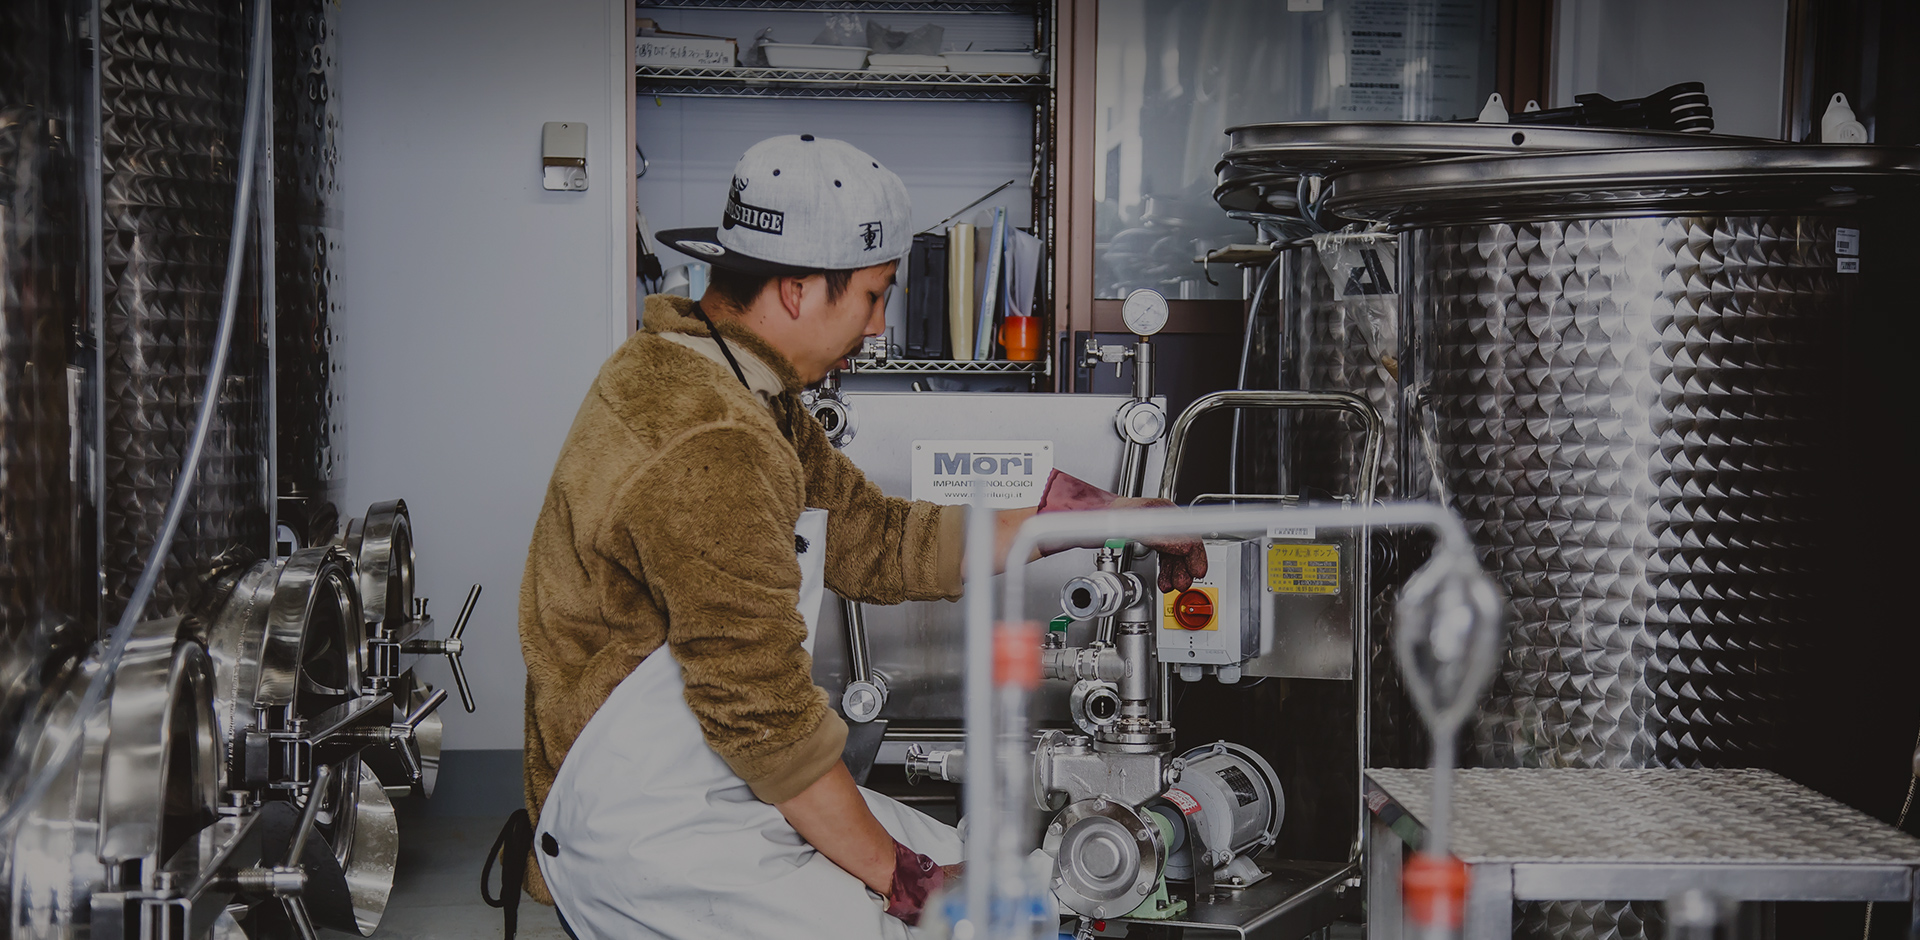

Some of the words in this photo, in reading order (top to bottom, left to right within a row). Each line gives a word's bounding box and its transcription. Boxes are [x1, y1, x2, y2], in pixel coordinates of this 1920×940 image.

[934, 452, 1033, 475] Mori
[1275, 548, 1294, 557] アサノ
